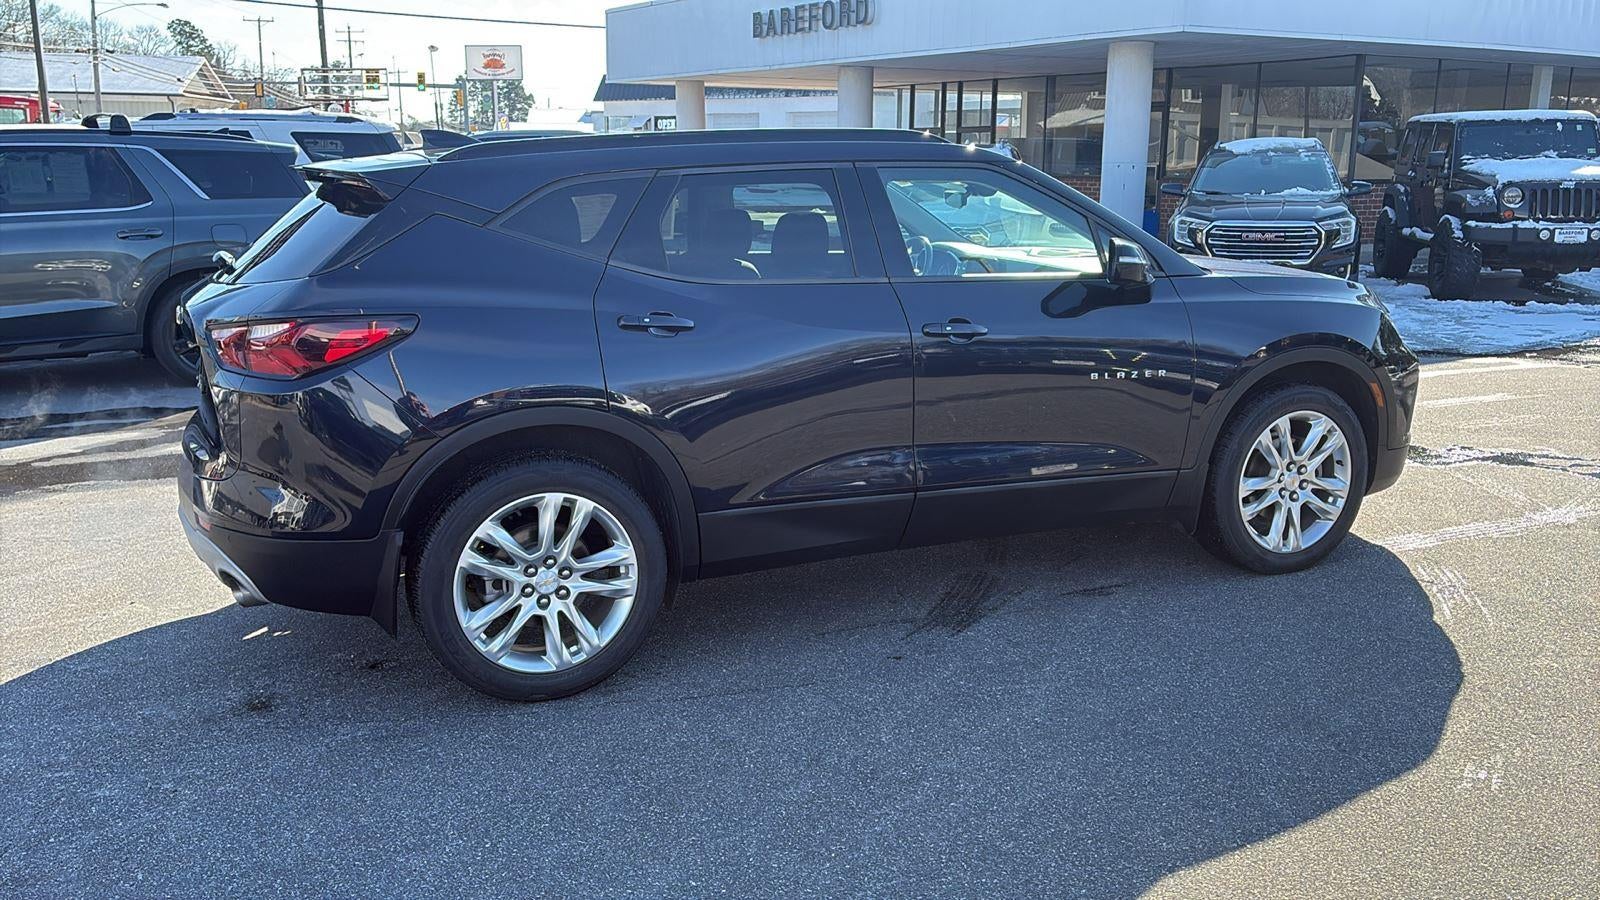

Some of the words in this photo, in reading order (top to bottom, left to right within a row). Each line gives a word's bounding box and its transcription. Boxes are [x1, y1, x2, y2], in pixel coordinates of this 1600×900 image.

[752, 0, 873, 38] BAREFORD
[657, 118, 676, 130] OPEN
[1241, 232, 1285, 241] GMC
[1090, 369, 1167, 380] BLAZER
